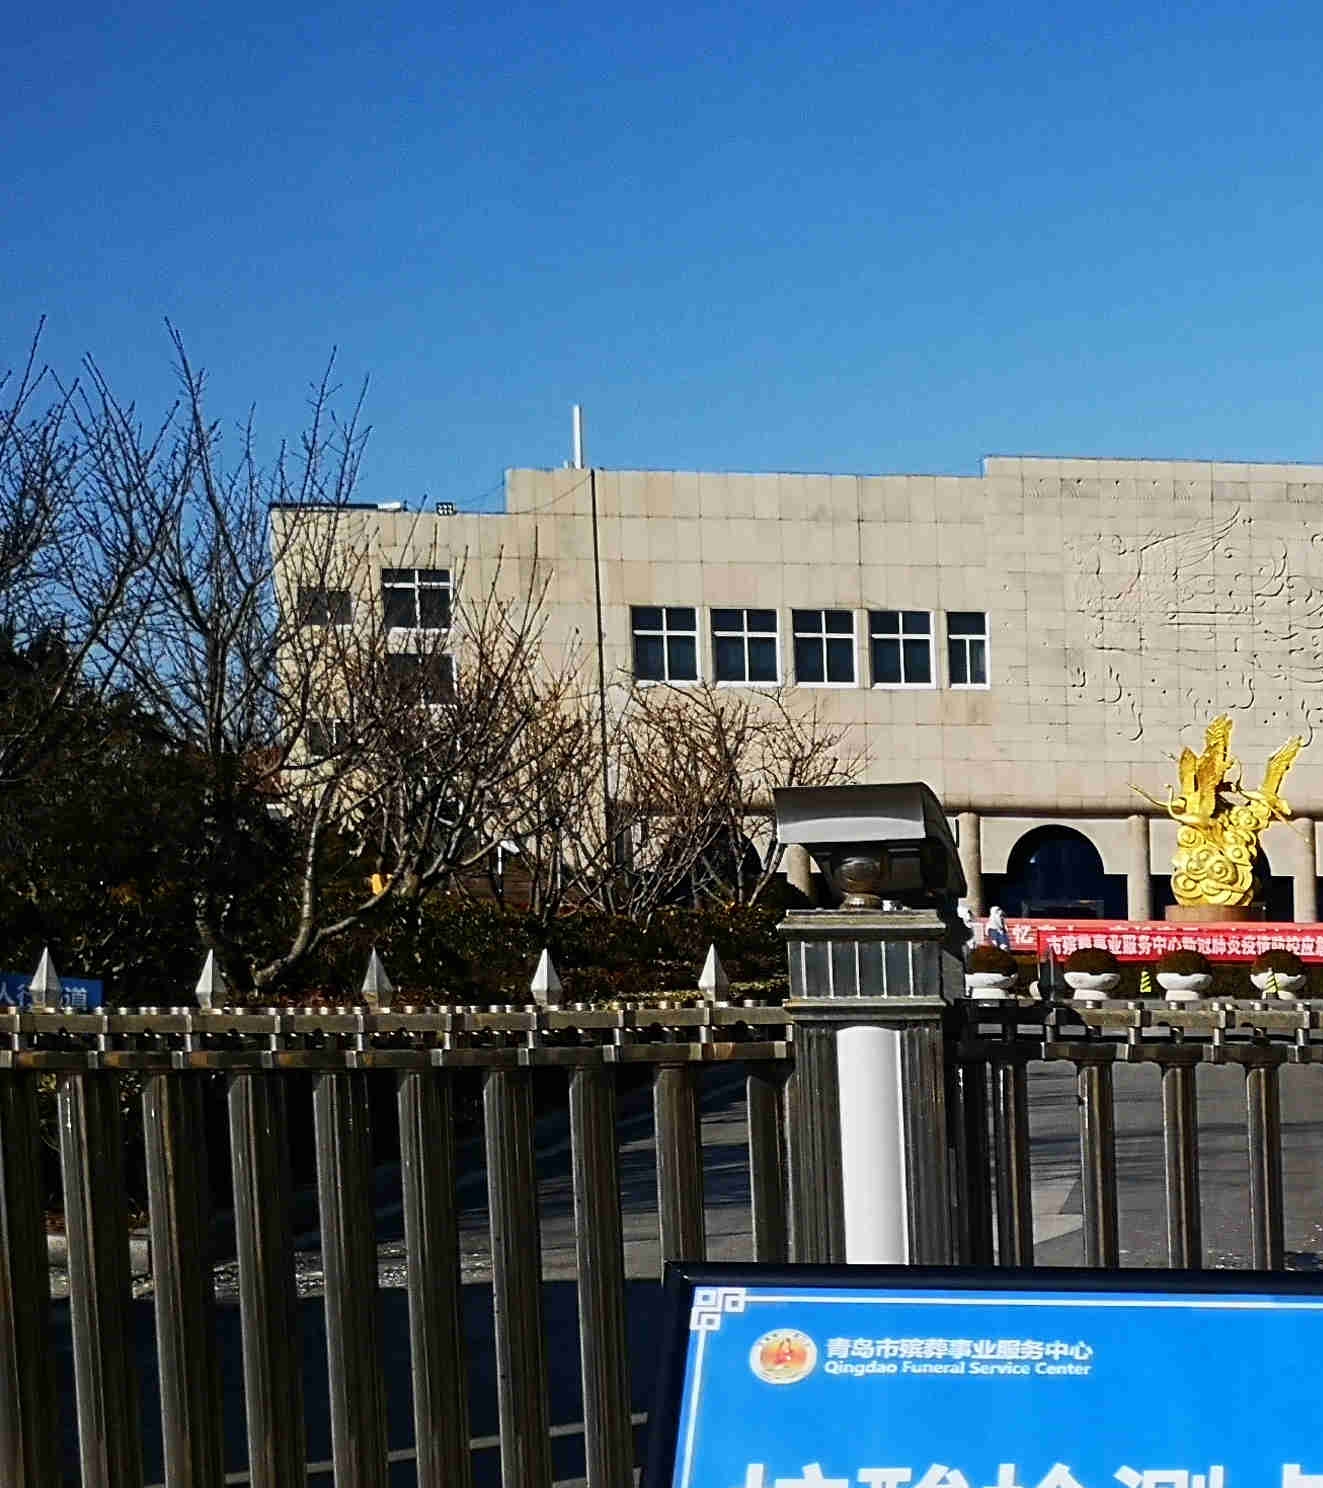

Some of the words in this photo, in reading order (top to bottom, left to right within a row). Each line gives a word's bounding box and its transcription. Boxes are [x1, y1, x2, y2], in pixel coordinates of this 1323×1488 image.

[827, 1337, 1094, 1361] 青岛市殡葬事业服务中心
[825, 1360, 899, 1377] Qingdao
[902, 1360, 965, 1375] Funeral
[968, 1361, 1031, 1375] Service
[1034, 1362, 1091, 1375] Center
